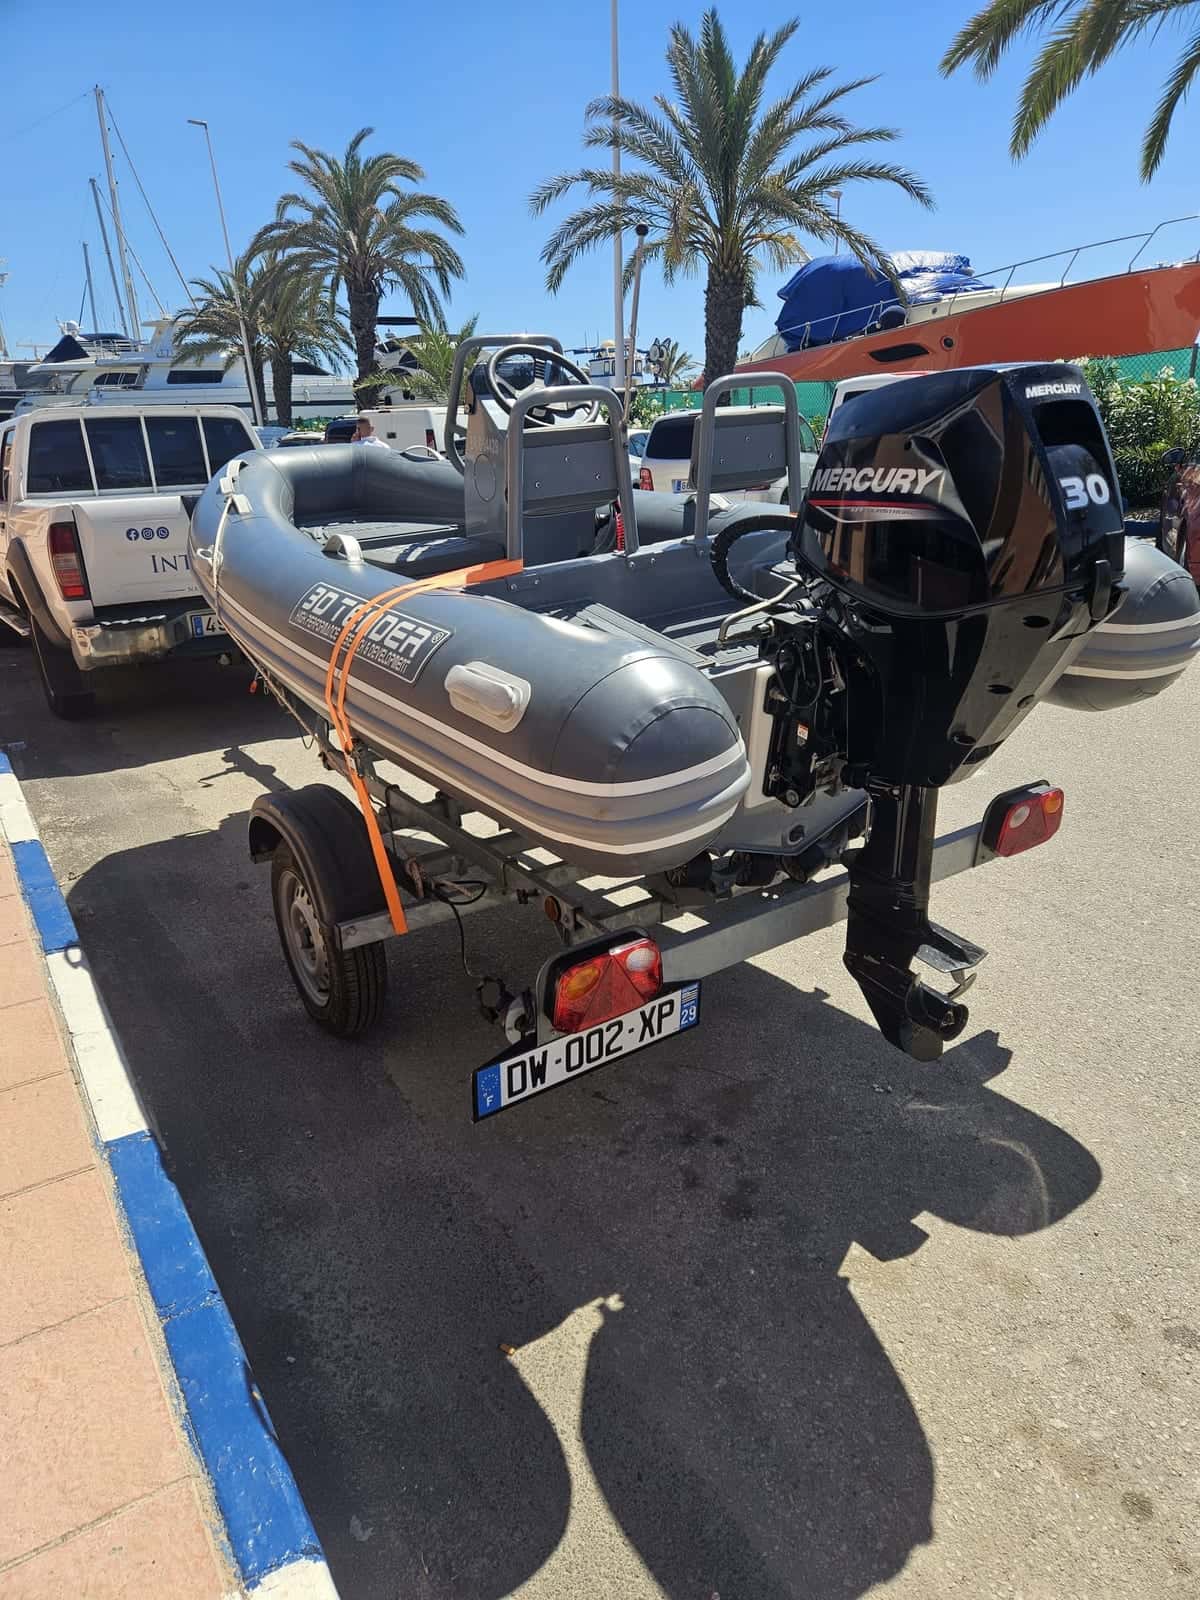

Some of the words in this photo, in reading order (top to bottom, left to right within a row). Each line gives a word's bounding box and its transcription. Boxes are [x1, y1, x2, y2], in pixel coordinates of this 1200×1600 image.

[1025, 383, 1082, 399] MERCURY
[811, 467, 943, 495] MERCURY
[1059, 473, 1110, 510] 30
[681, 1005, 697, 1025] 29
[507, 999, 675, 1099] DW-002-XP
[486, 1095, 494, 1108] F
